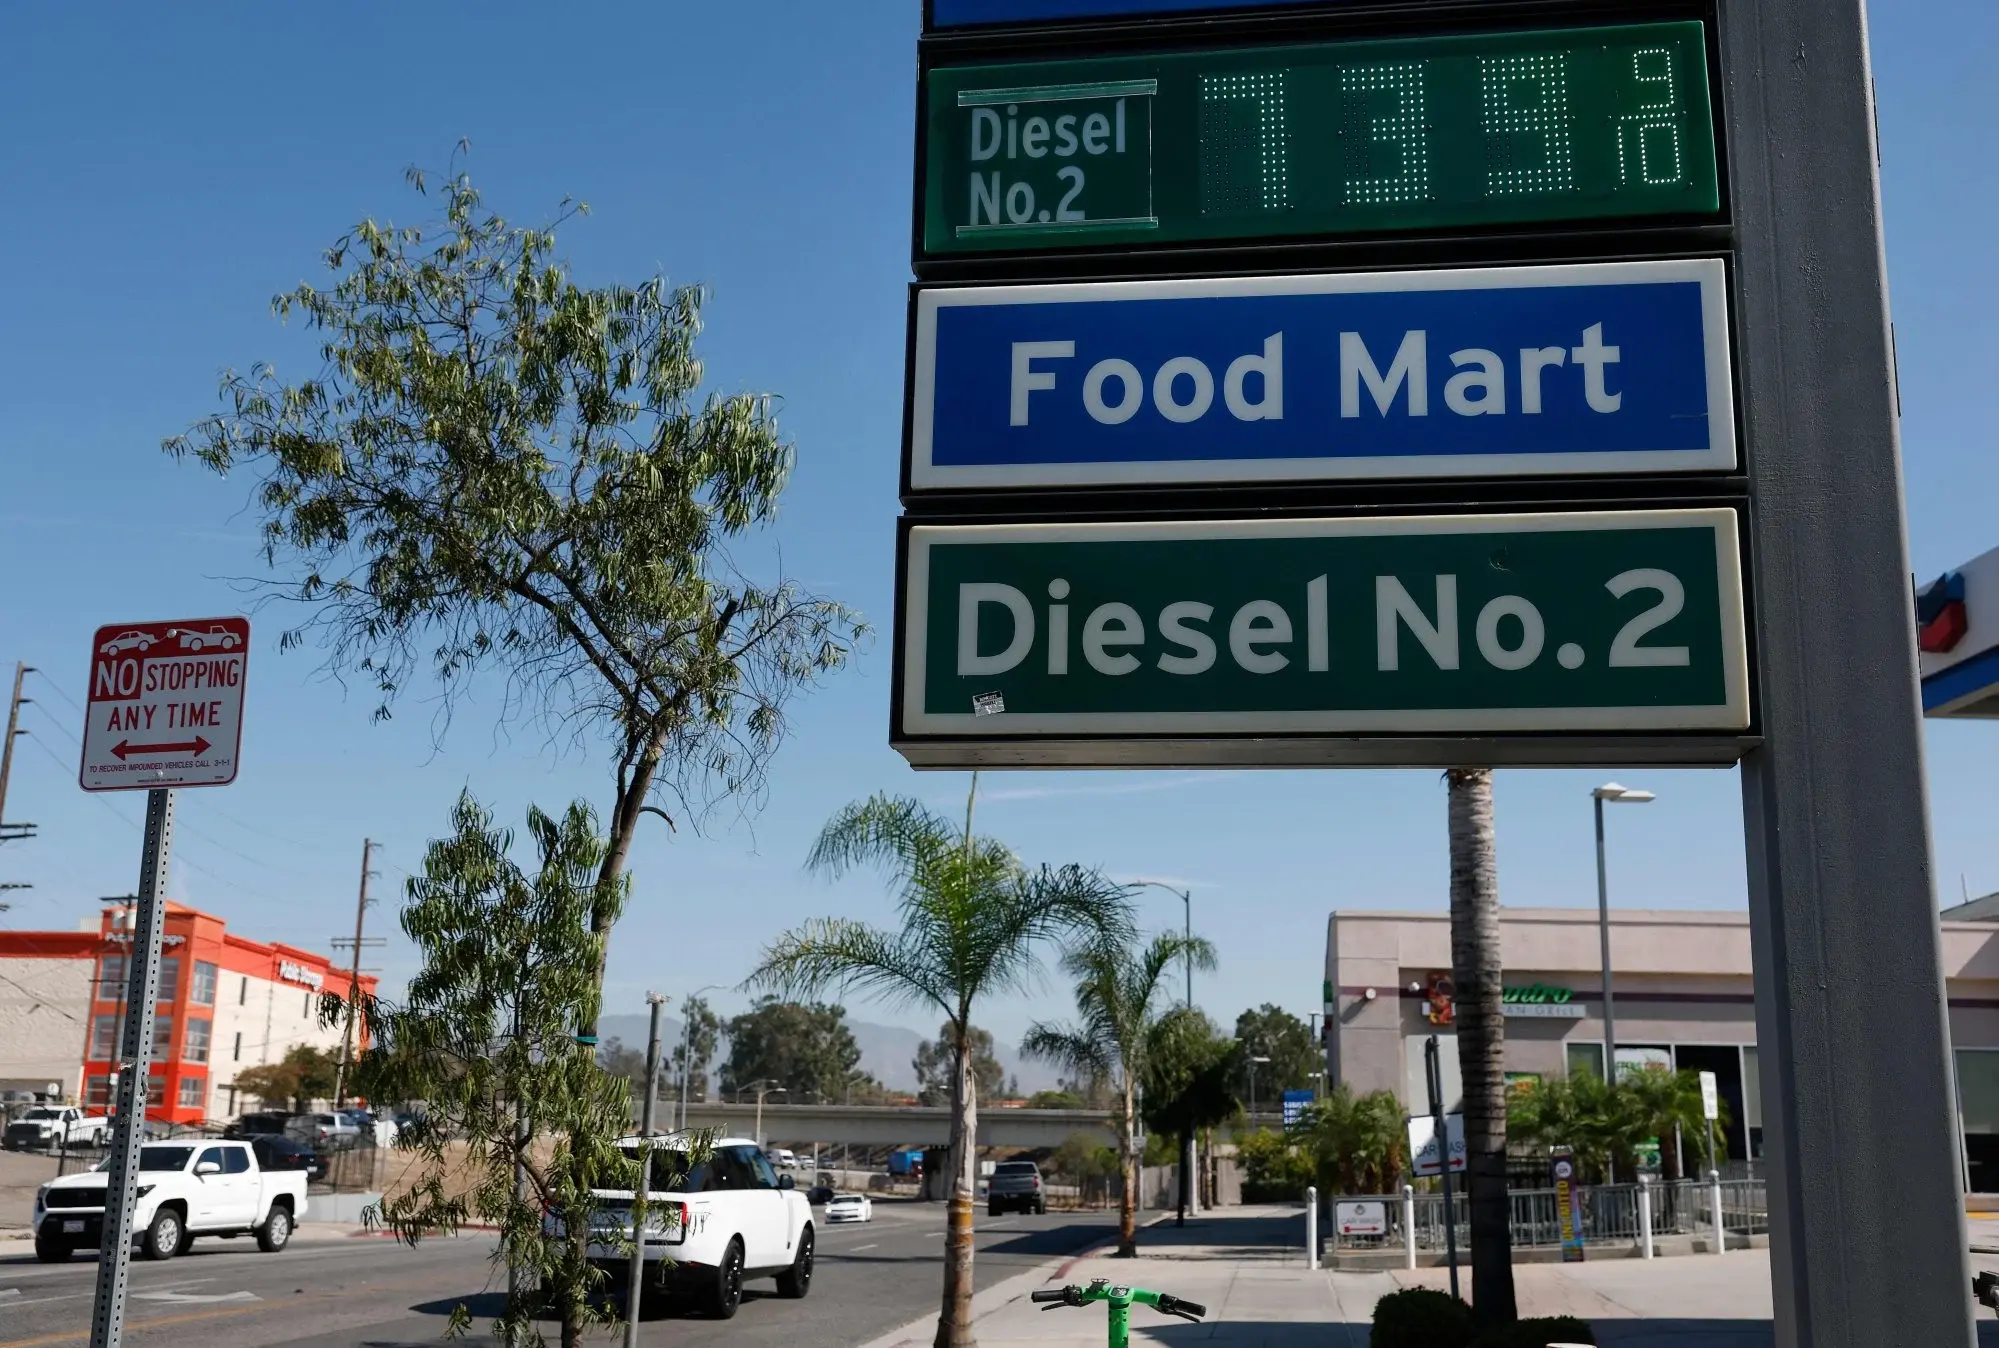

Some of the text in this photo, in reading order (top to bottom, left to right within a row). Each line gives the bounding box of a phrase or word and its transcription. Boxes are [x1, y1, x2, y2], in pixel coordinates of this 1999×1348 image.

[971, 96, 1126, 161] Diesel
[970, 165, 1086, 226] No.2
[1009, 321, 1623, 427] Food Mart
[956, 568, 1691, 677] Diesel No.2
[95, 658, 240, 697] NO STOPPING
[106, 701, 222, 732] ANY TIME
[89, 765, 98, 773] TO
[98, 763, 127, 773] RECOVER
[128, 762, 163, 772] IMPOUNDED
[164, 760, 194, 769] VEHICLES
[195, 760, 210, 768] CALL
[1415, 1142, 1439, 1158] CAR
